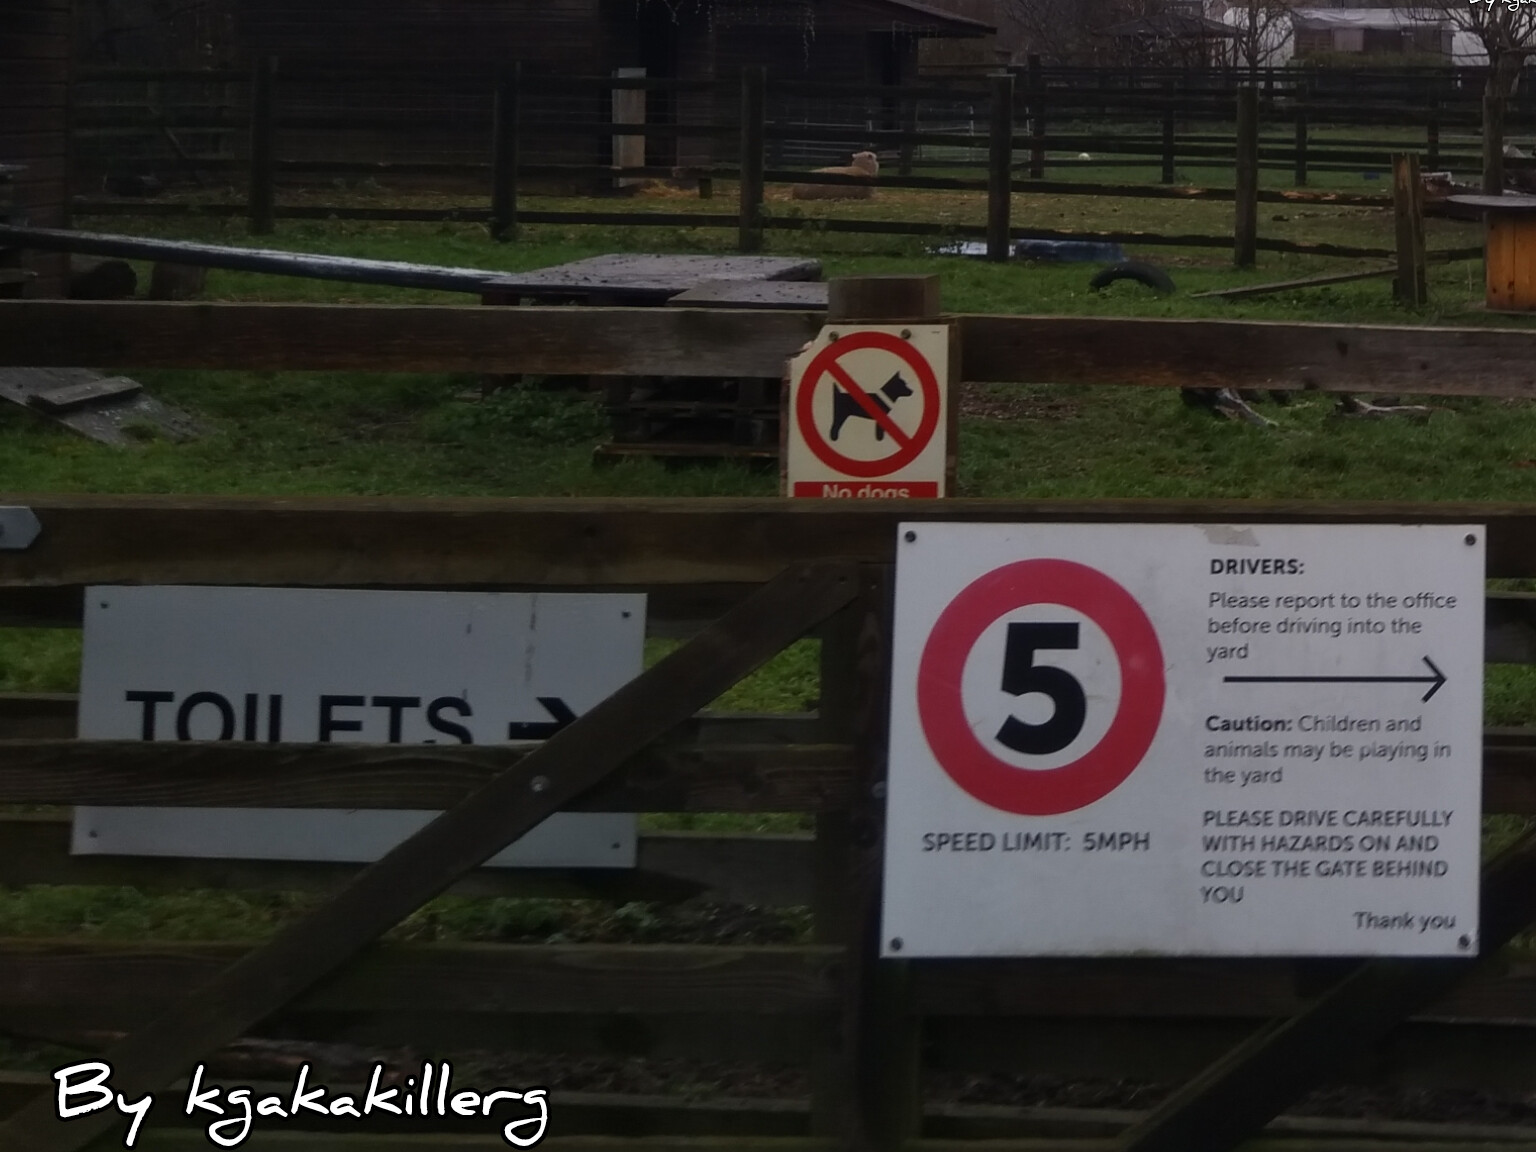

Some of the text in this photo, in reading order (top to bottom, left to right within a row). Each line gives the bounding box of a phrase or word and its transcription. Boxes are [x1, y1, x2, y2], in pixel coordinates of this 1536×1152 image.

[822, 484, 910, 498] No dogs
[1210, 558, 1305, 575] DRIVERS:
[1208, 592, 1457, 612] Please report to the office
[1207, 617, 1423, 638] before driving into the
[1206, 644, 1249, 663] yard
[994, 621, 1088, 756] 5
[1205, 715, 1422, 733] Caution: Children and
[1204, 741, 1452, 762] animals may be playing in
[1204, 767, 1284, 787] the yard
[1202, 810, 1454, 827] PLEASE DRIVE CAREFULLY
[922, 832, 1151, 852] SPEED LIMIT: 5MPH
[1202, 835, 1440, 853] WITH HAZARDS ON AND
[1201, 860, 1449, 878] CLOSE THE GATE BEHIND
[1200, 886, 1245, 904] YOU
[1353, 911, 1457, 934] Thank you
